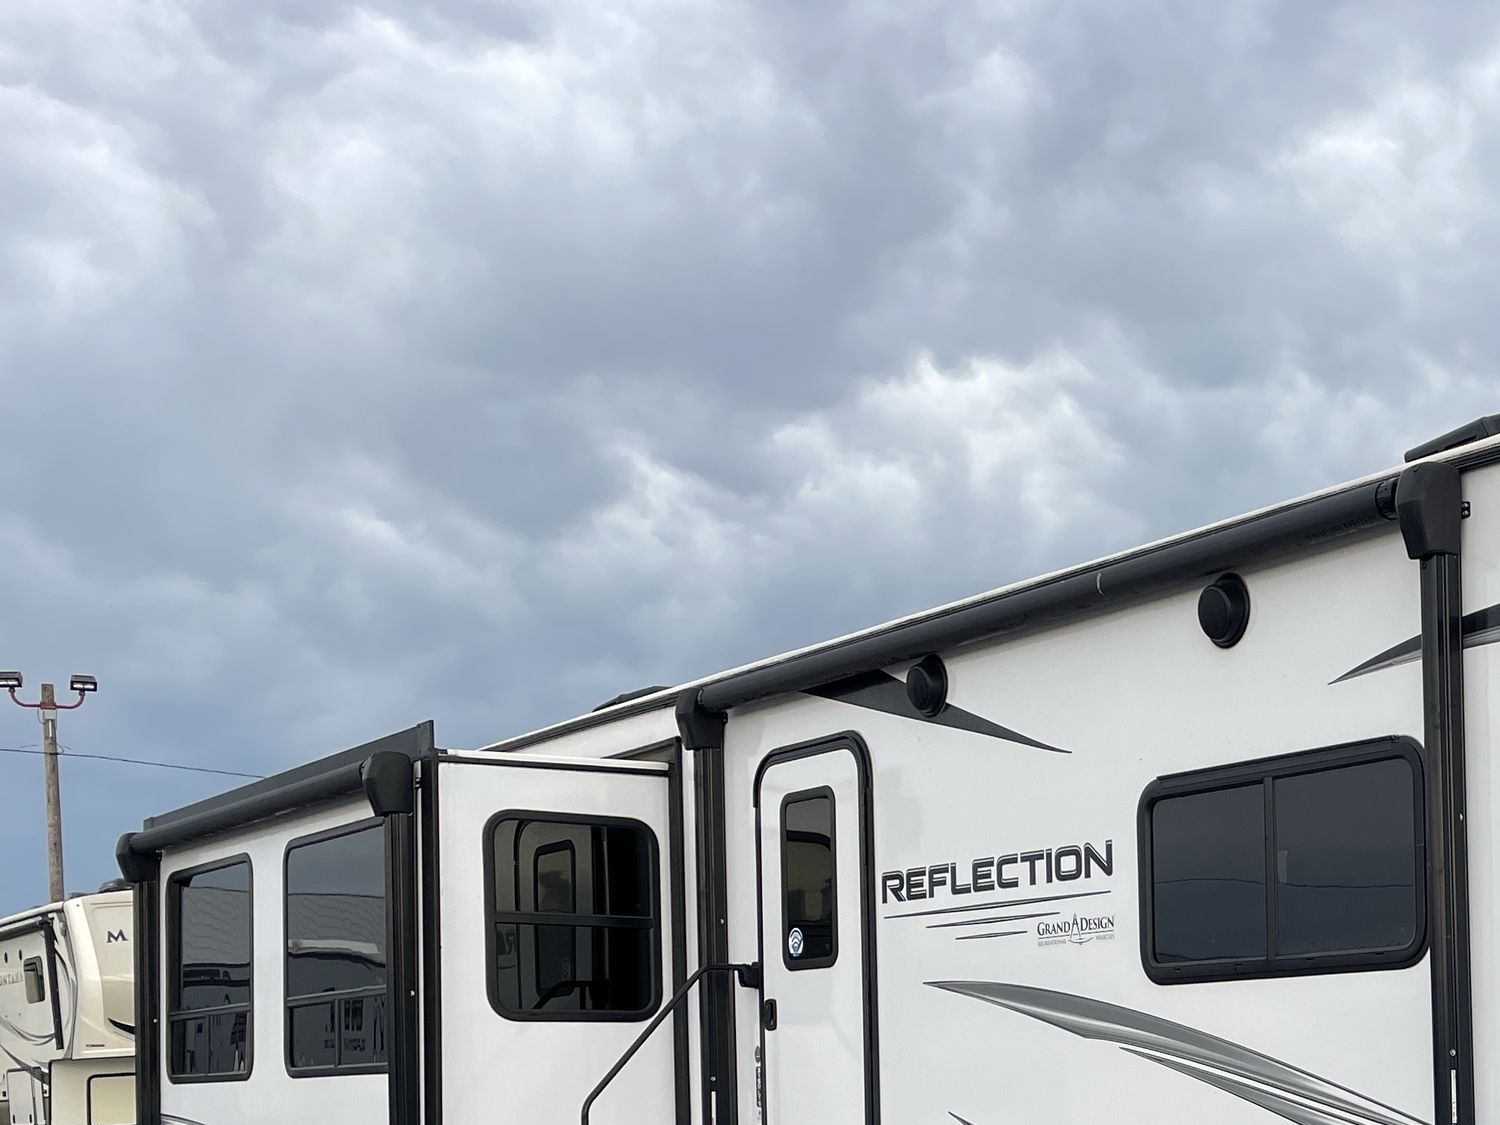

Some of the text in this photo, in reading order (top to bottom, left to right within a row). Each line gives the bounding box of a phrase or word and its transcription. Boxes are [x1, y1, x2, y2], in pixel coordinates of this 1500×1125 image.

[881, 839, 1113, 904] REFLECTION
[1037, 915, 1115, 936] GRAND DESIGN
